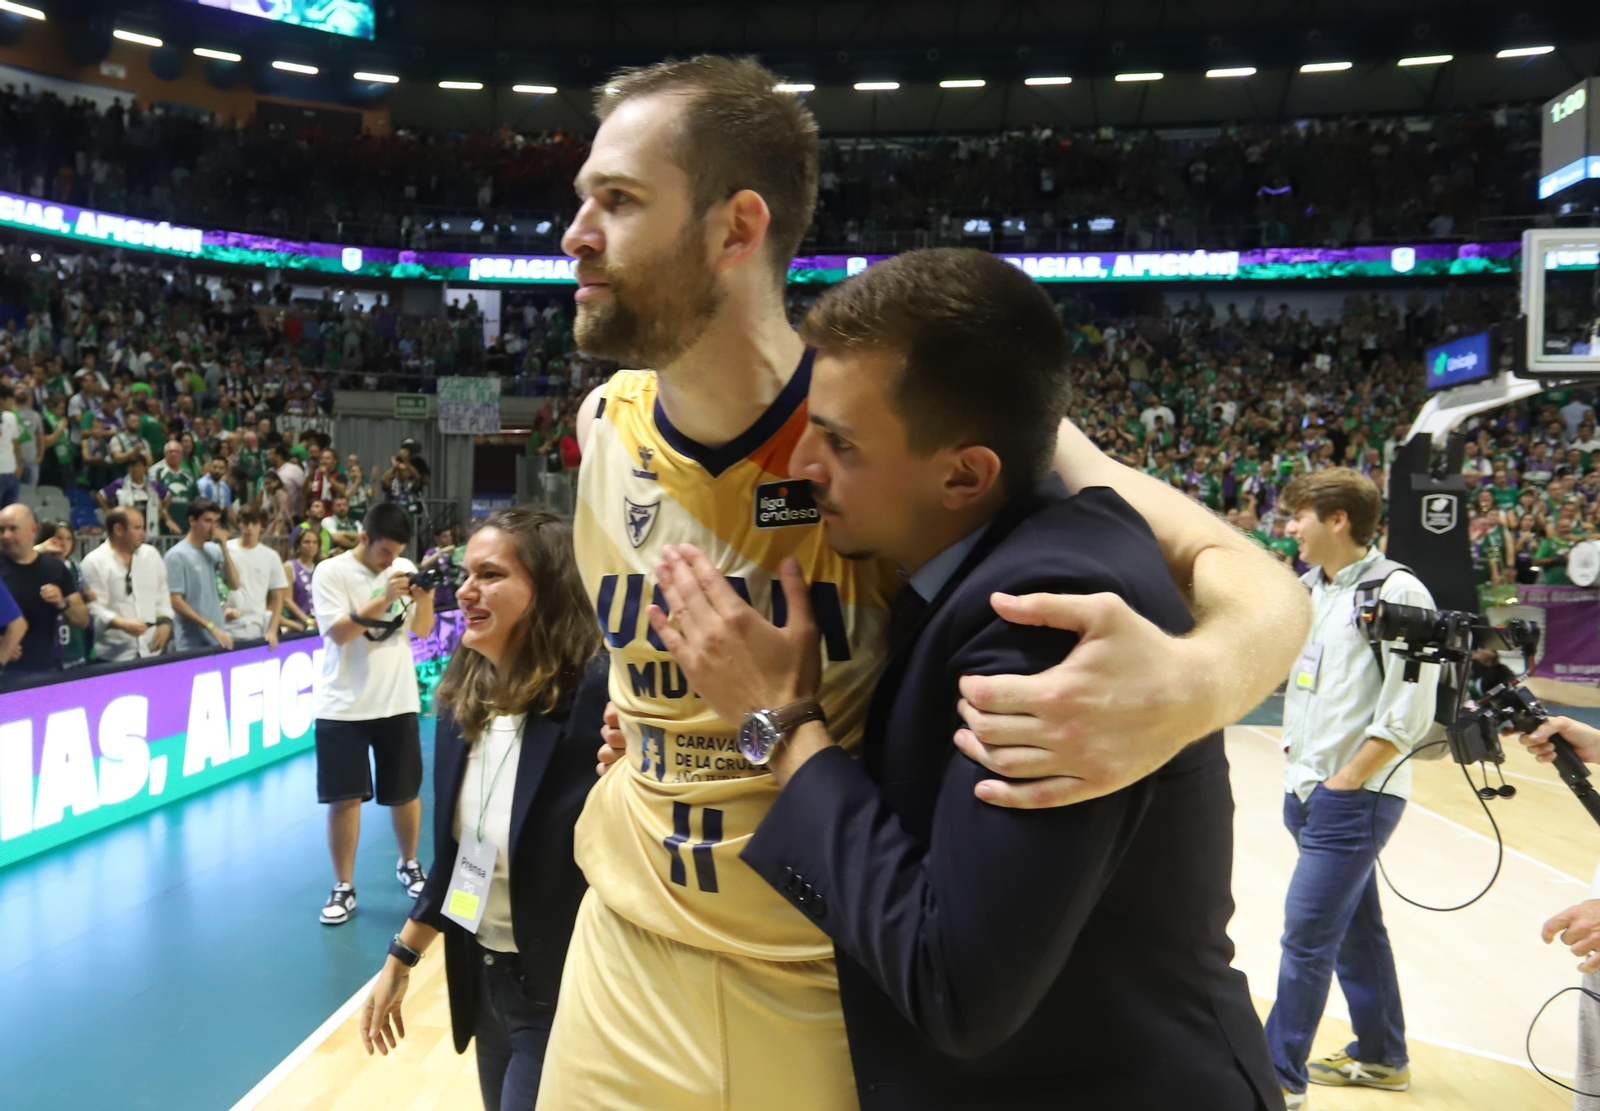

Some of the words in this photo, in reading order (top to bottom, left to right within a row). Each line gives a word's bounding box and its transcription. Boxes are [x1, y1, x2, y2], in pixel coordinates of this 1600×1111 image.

[75, 211, 203, 254] AFICIÓN!
[1112, 250, 1239, 277] AFICIÓN!
[760, 497, 786, 511] liga
[760, 508, 818, 522] endesa
[675, 752, 692, 767] DE
[695, 755, 711, 769] LA
[663, 801, 724, 894] 11
[460, 856, 487, 879] Prensa
